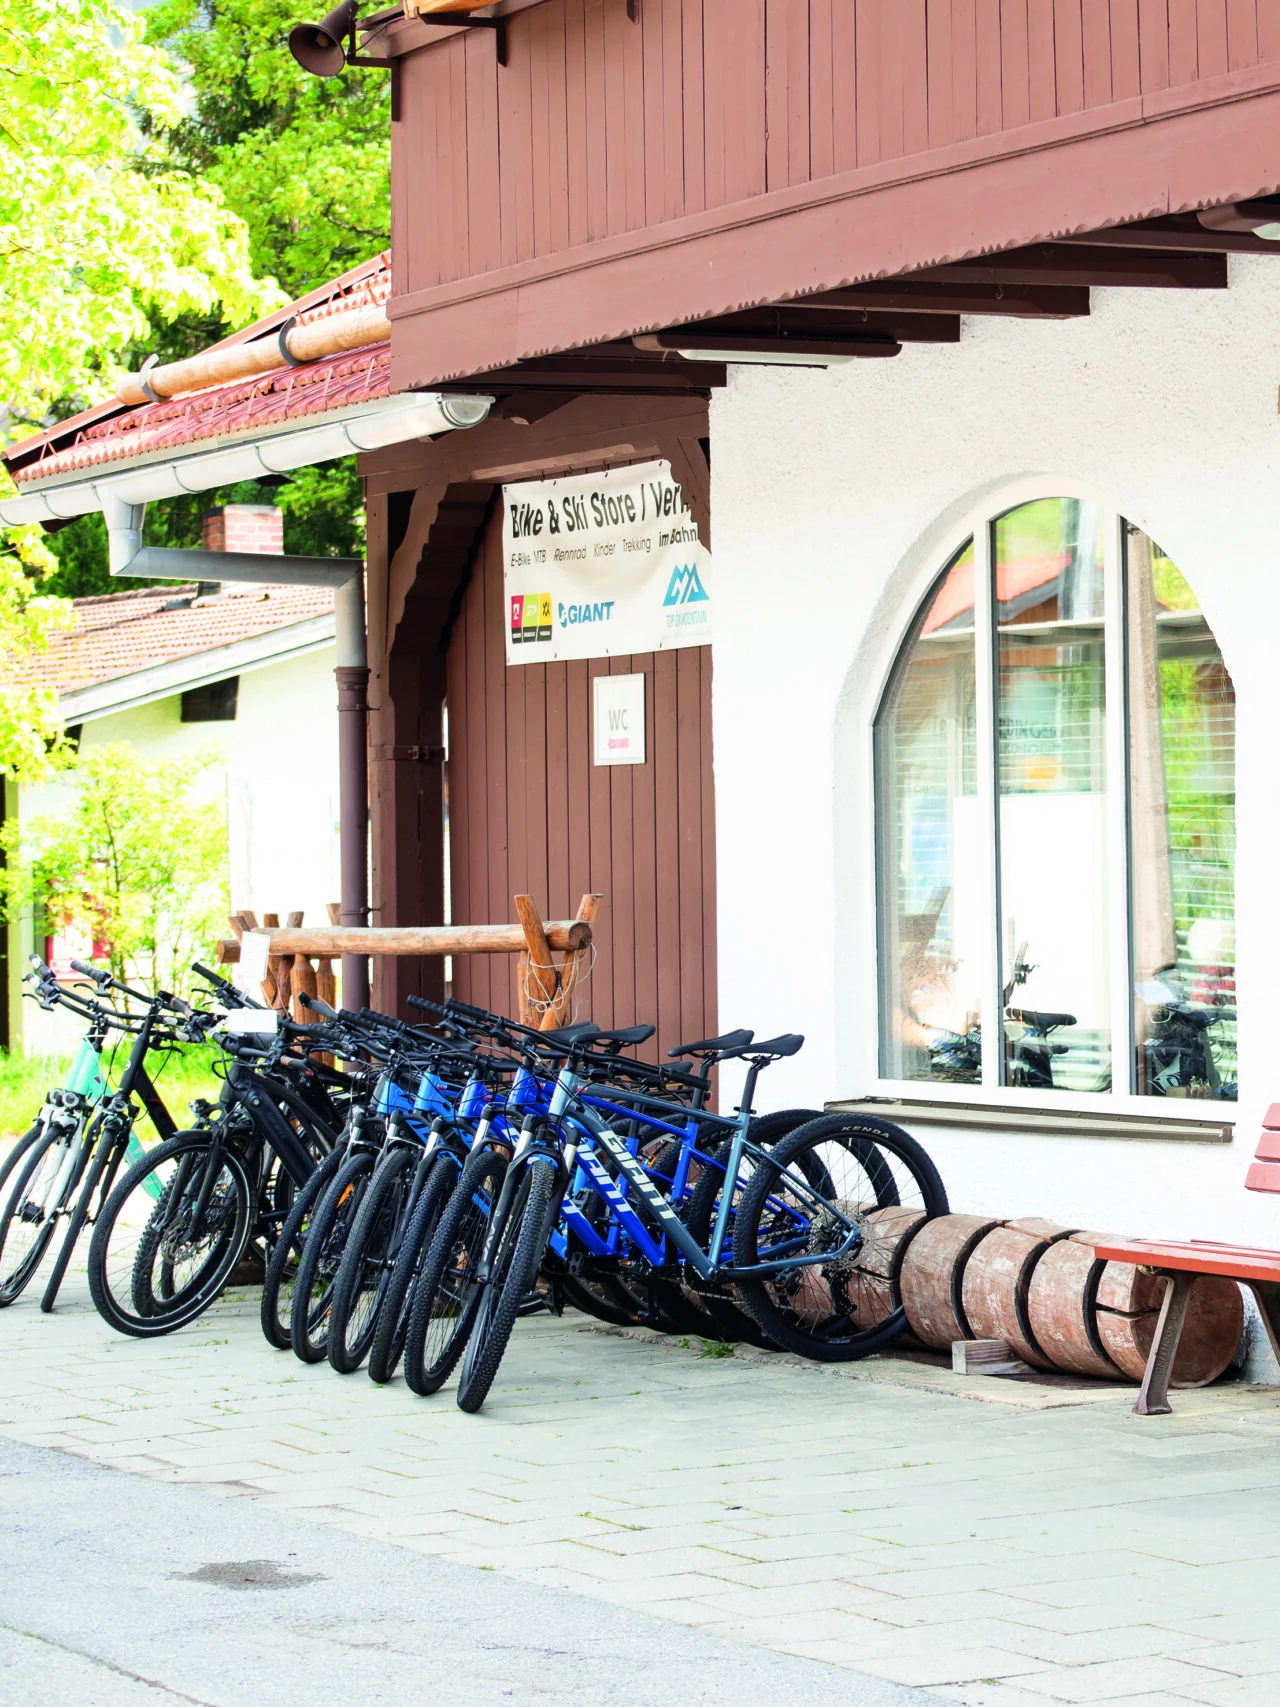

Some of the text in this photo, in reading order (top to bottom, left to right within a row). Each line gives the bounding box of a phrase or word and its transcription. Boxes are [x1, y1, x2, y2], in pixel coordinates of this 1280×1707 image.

[510, 502, 543, 538] Bike
[547, 499, 561, 534] &
[562, 494, 589, 532] Ski
[590, 492, 636, 528] Store
[510, 552, 531, 567] E-Bike
[552, 547, 587, 562] Rennrad
[593, 543, 616, 557] Kinder
[622, 537, 651, 553] Trekking
[568, 601, 615, 624] GIANT
[608, 708, 628, 731] WC
[841, 1126, 890, 1138] KENDA
[576, 1137, 633, 1213] IANT
[598, 1130, 676, 1219] GIANT
